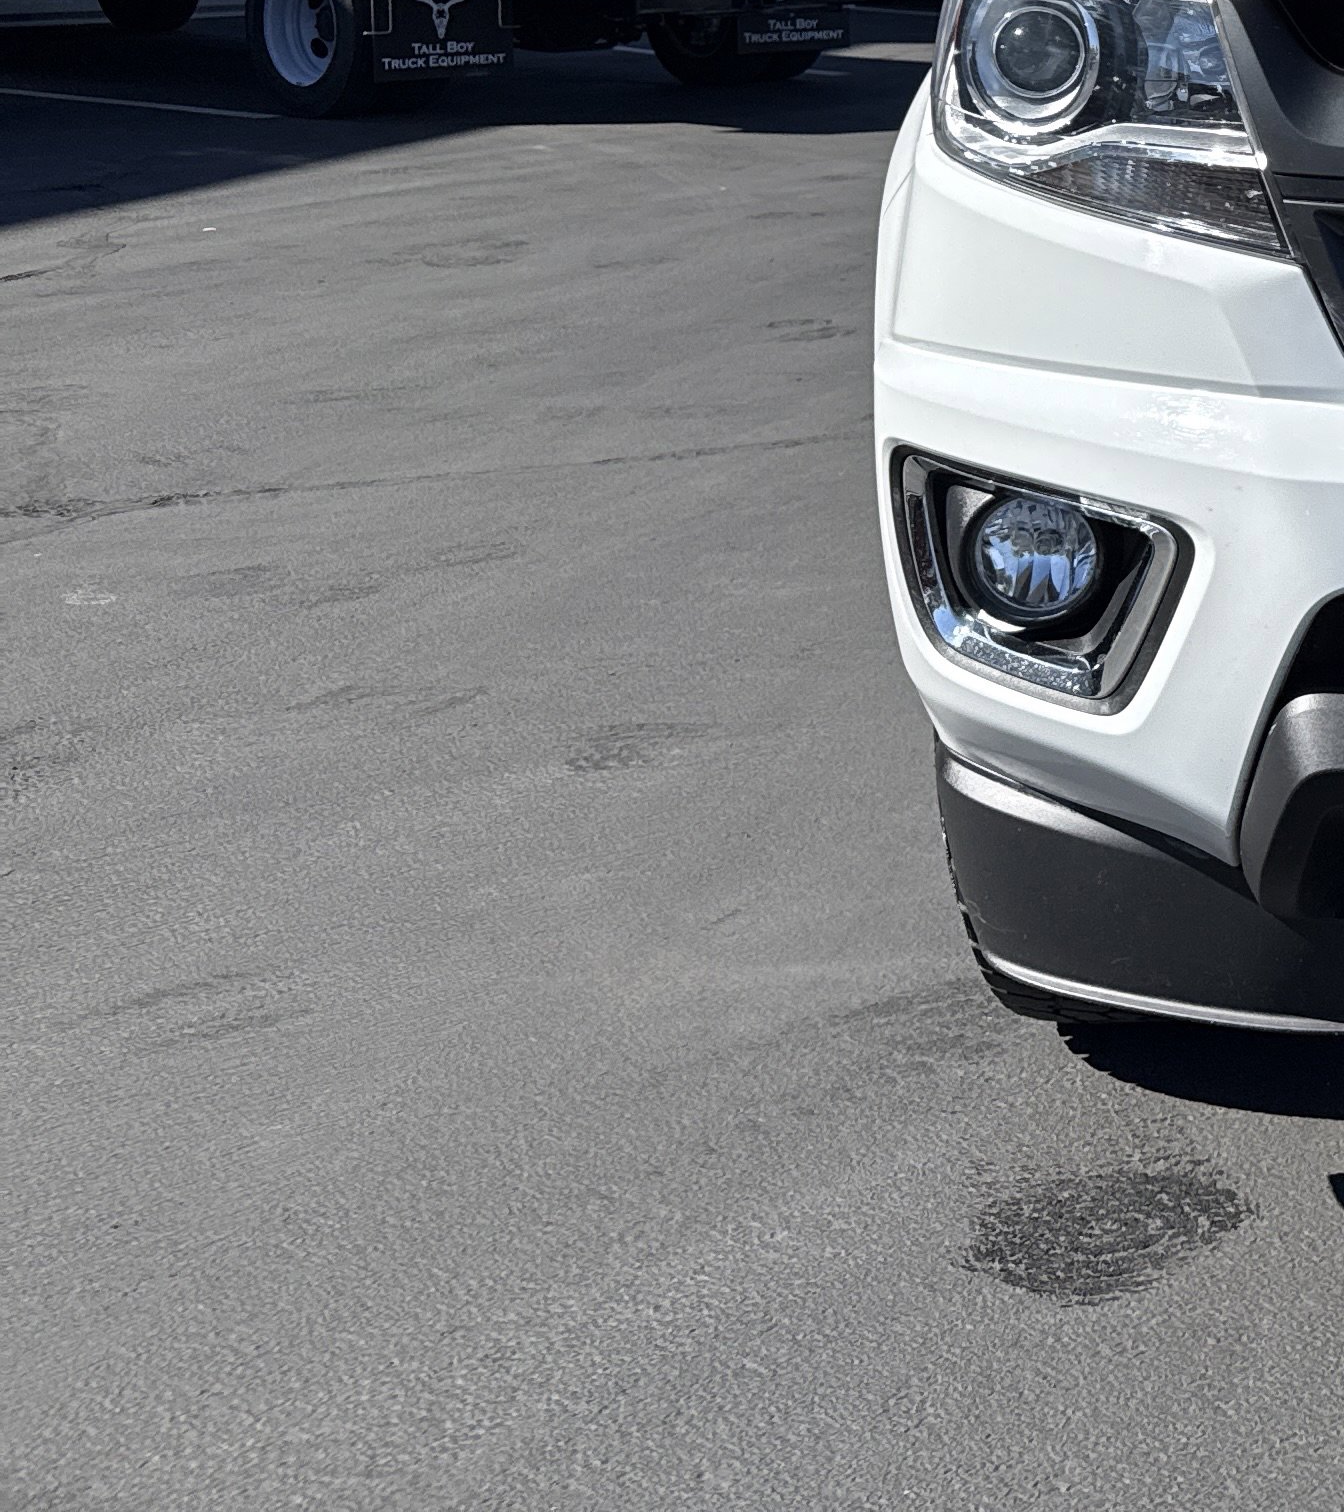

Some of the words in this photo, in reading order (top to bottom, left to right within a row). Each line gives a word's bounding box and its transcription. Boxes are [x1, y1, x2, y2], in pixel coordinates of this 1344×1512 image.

[412, 43, 444, 55] TALL
[447, 41, 474, 53] BOY
[382, 57, 426, 70] TRUCK
[429, 53, 506, 67] EQUIPMENT
